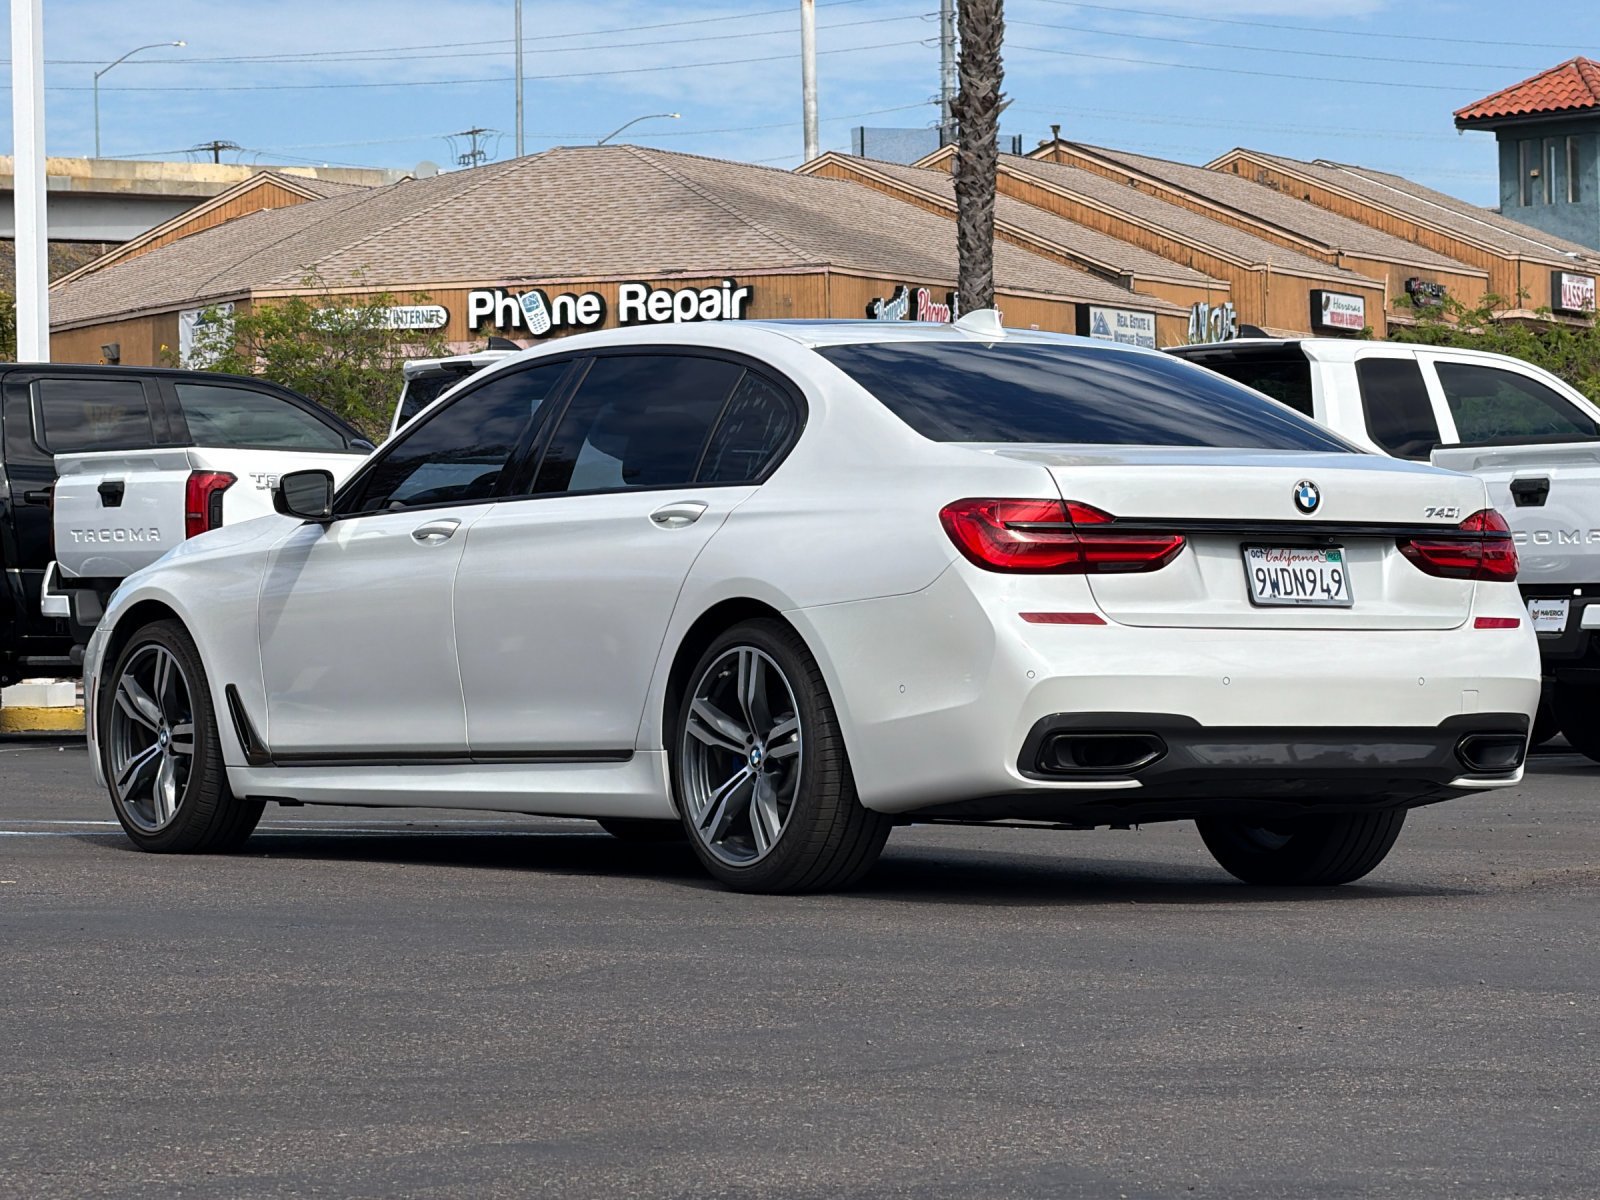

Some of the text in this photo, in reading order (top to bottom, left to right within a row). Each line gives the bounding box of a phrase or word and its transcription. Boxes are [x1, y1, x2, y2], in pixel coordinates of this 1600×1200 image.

[618, 280, 748, 323] Repair
[392, 309, 441, 326] INTERNET
[1425, 507, 1460, 519] 740i
[70, 527, 161, 543] TACOMA
[1265, 547, 1321, 567] California
[1255, 567, 1343, 597] 9WDN949
[1540, 609, 1565, 617] MAVERICK
